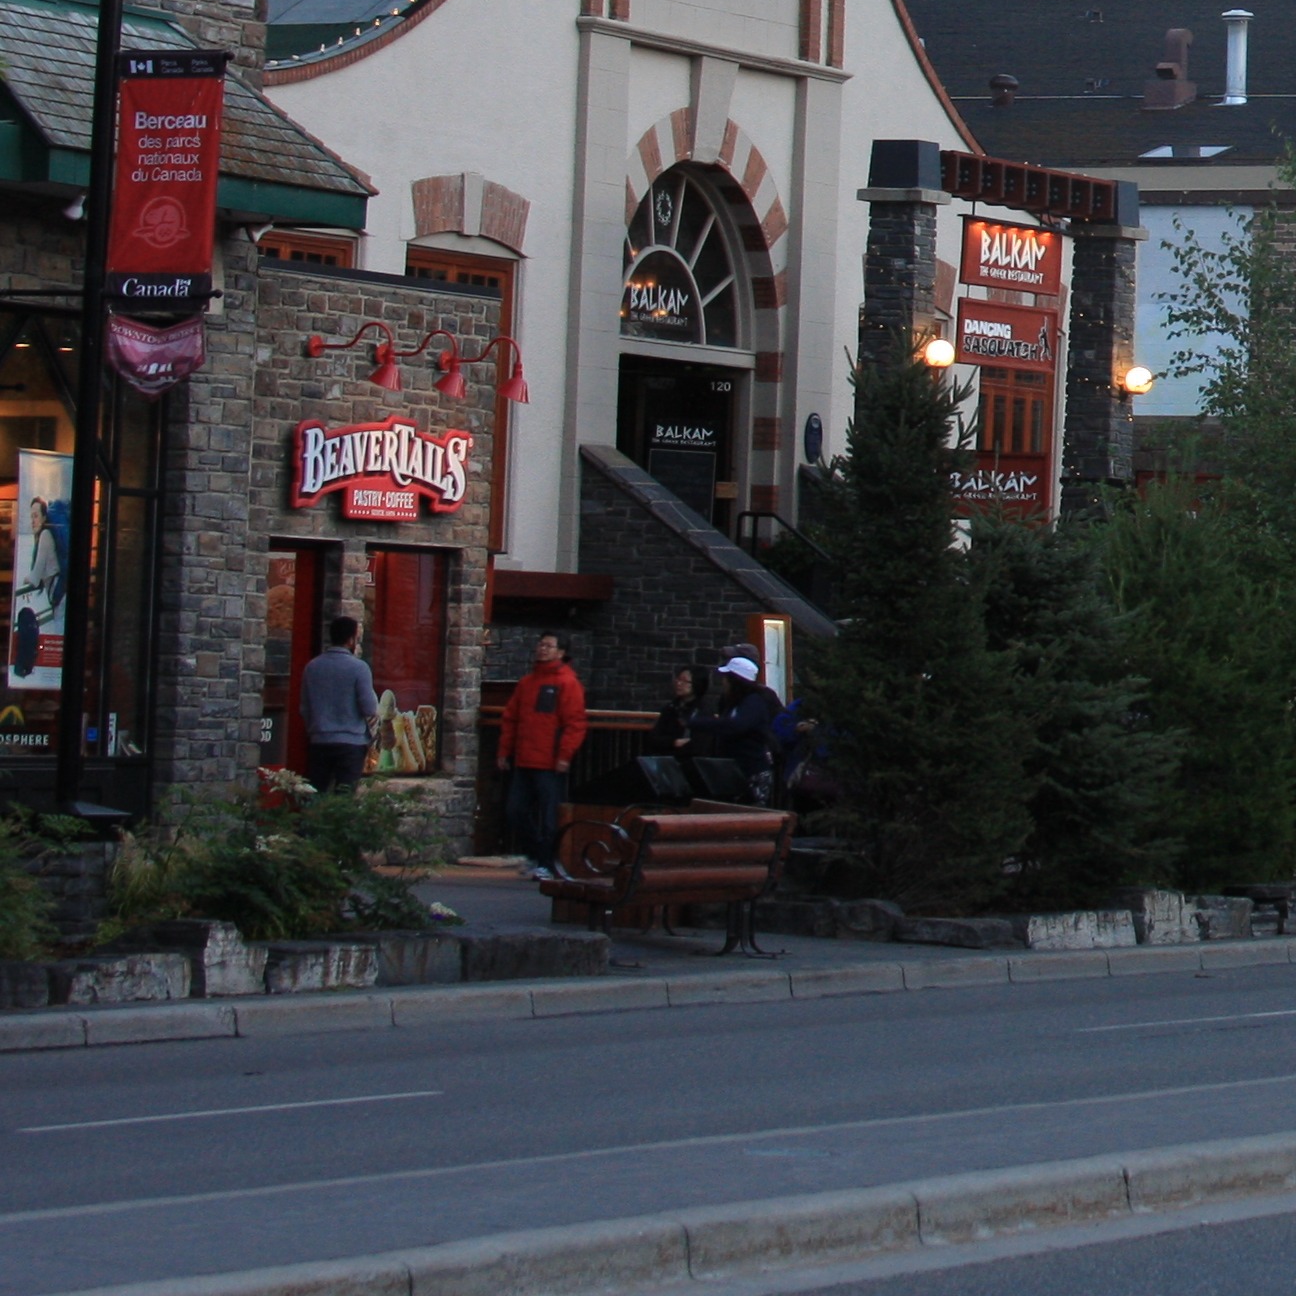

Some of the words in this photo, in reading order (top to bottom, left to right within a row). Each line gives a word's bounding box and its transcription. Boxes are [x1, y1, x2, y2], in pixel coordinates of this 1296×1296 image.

[134, 111, 208, 130] Berceau
[137, 134, 163, 149] des
[165, 131, 202, 151] parcs
[137, 152, 200, 165] nationaux
[131, 168, 149, 182] du
[151, 166, 203, 182] Canada
[980, 229, 1047, 271] BALKAN
[121, 277, 192, 297] Canada
[629, 281, 690, 316] BALKAN
[964, 319, 1012, 339] DANCING
[963, 336, 1039, 361] SASQUATCH
[710, 381, 732, 392] 120
[655, 424, 714, 441] BALKAN
[950, 470, 1038, 493] BALKAN
[353, 489, 383, 507] PASTRY
[385, 491, 415, 509] COFFEE
